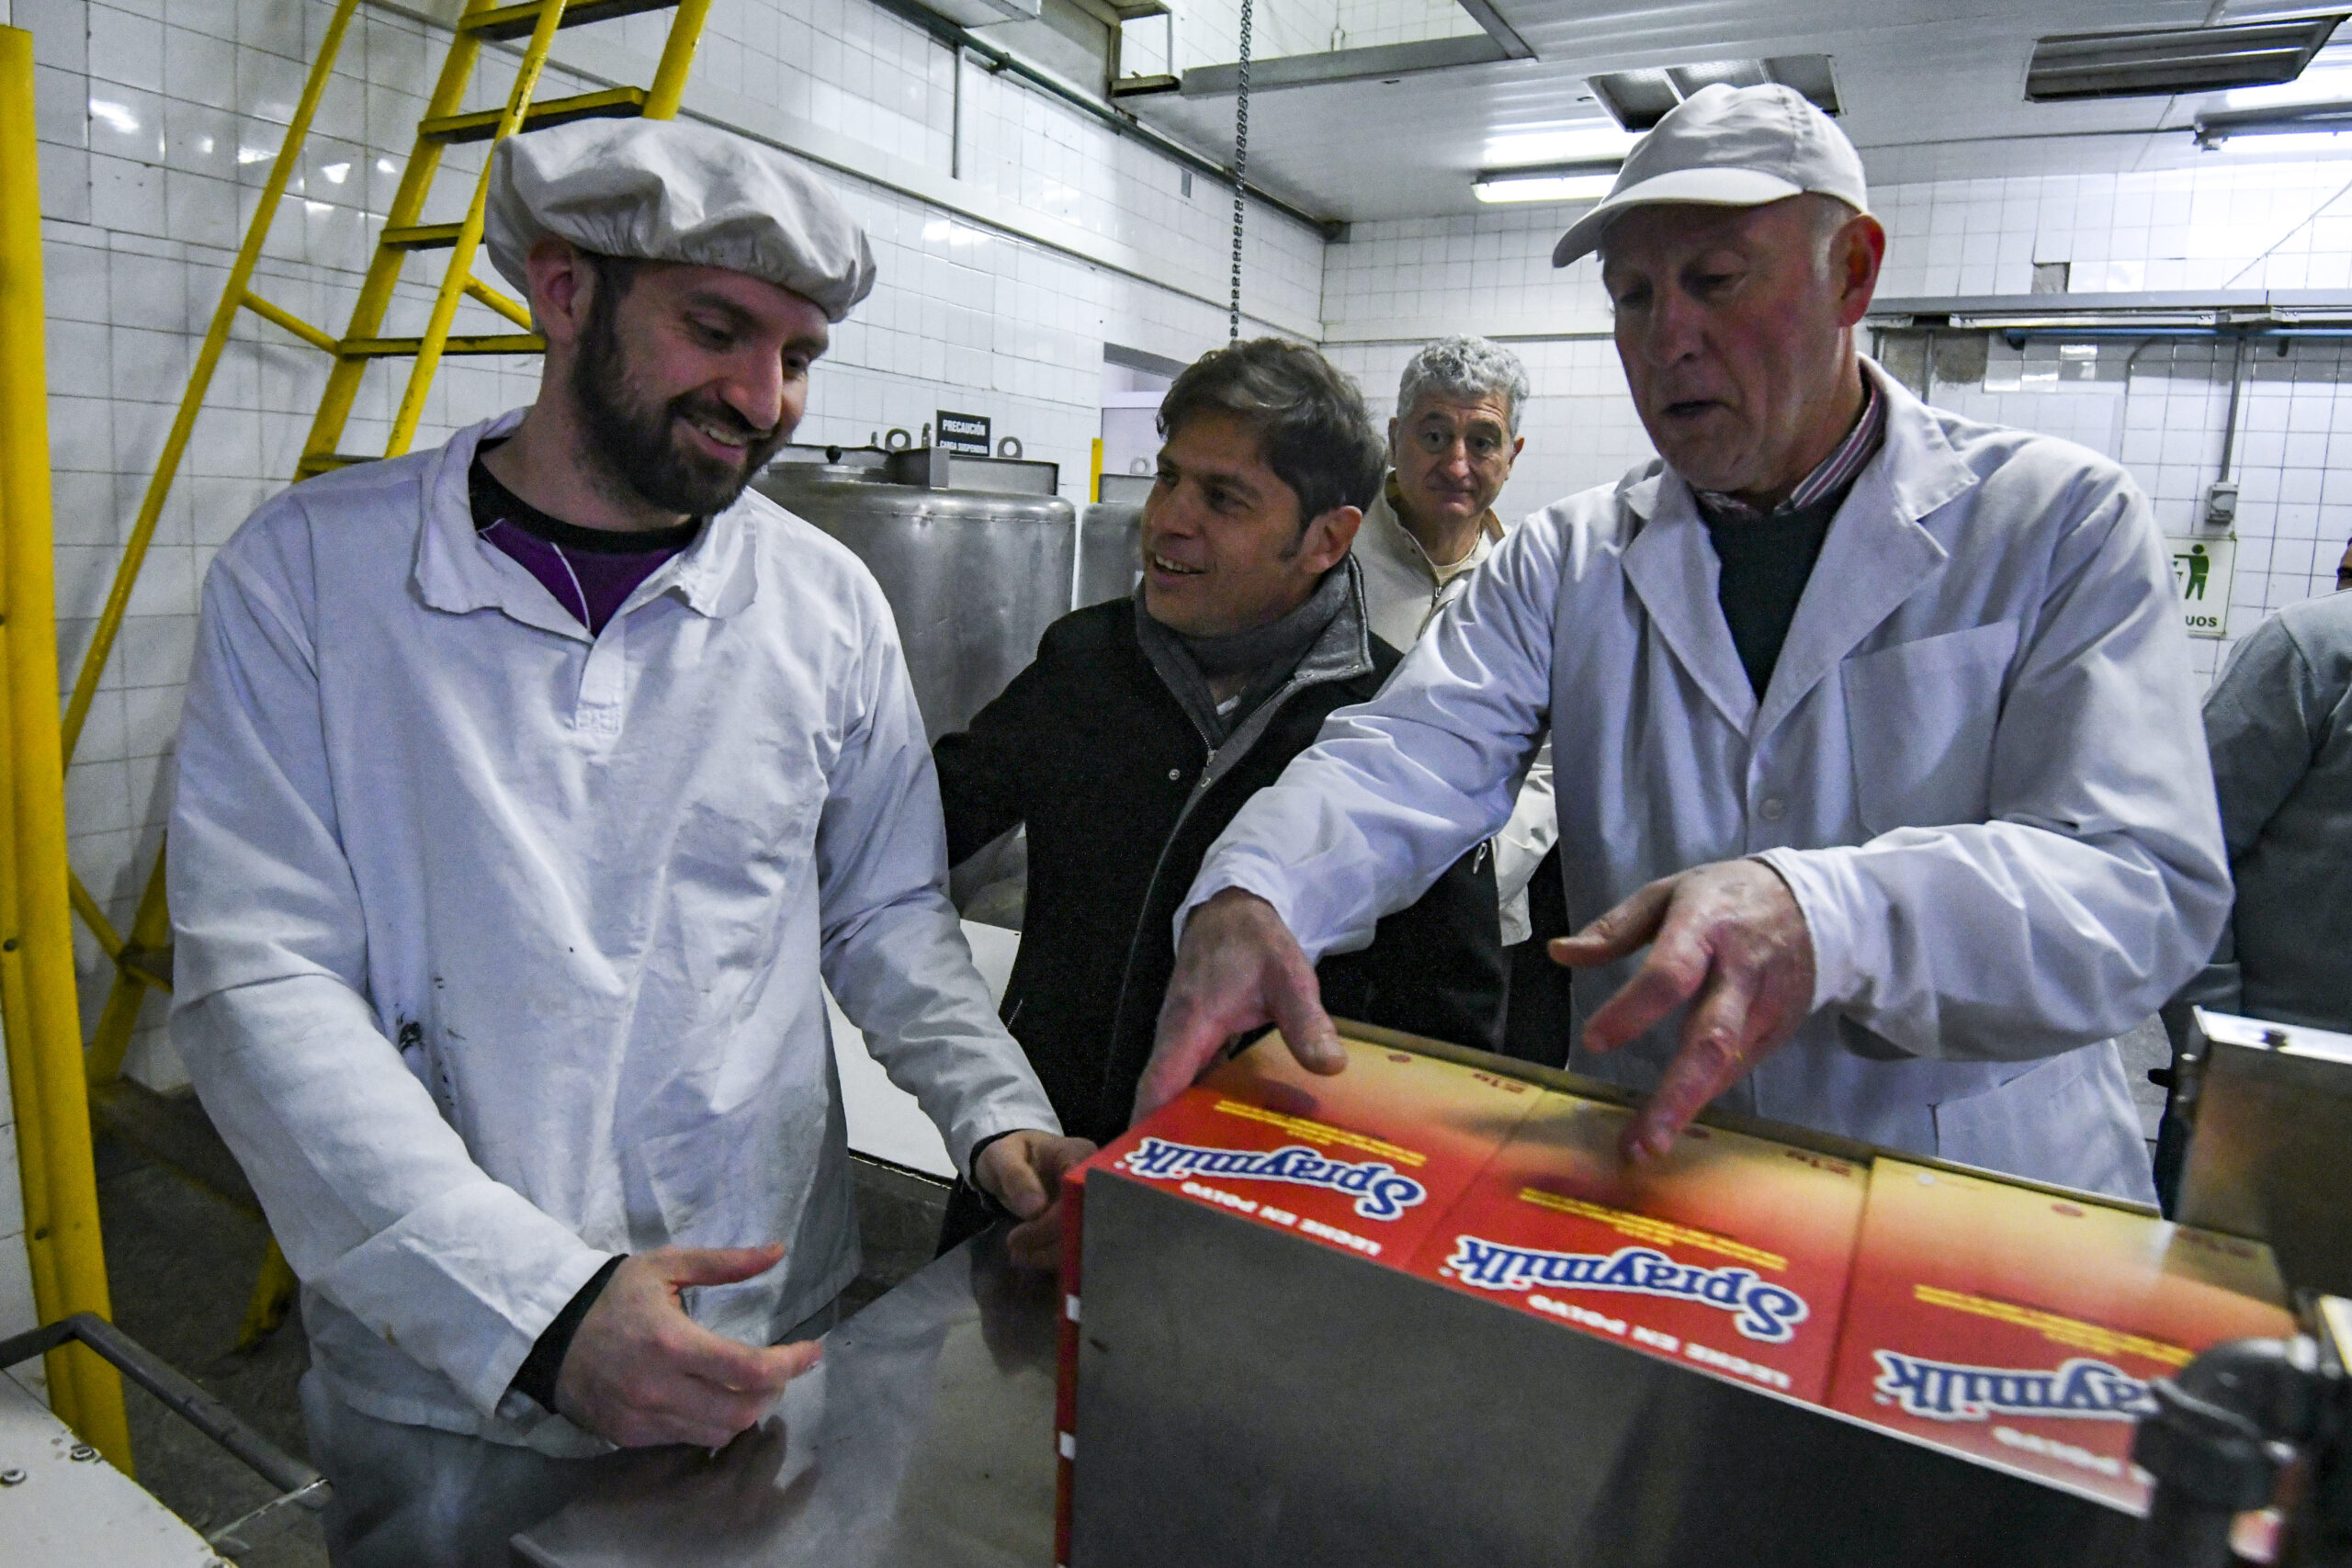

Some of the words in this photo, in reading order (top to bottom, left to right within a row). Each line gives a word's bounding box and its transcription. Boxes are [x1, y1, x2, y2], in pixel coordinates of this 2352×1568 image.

[943, 419, 986, 436] PRECAUCIÓN
[2185, 615, 2218, 626] UOS
[1124, 1136, 1427, 1222] Spraymilk
[1182, 1181, 1258, 1213] POLVO
[1260, 1204, 1298, 1225] EN
[1298, 1218, 1381, 1256] LECHE
[1446, 1235, 1809, 1344] Spraymilk
[1528, 1294, 1627, 1336] POLVO
[1633, 1325, 1679, 1353] EN
[1685, 1342, 1791, 1389] LECHE
[1873, 1349, 2159, 1423] aymilk
